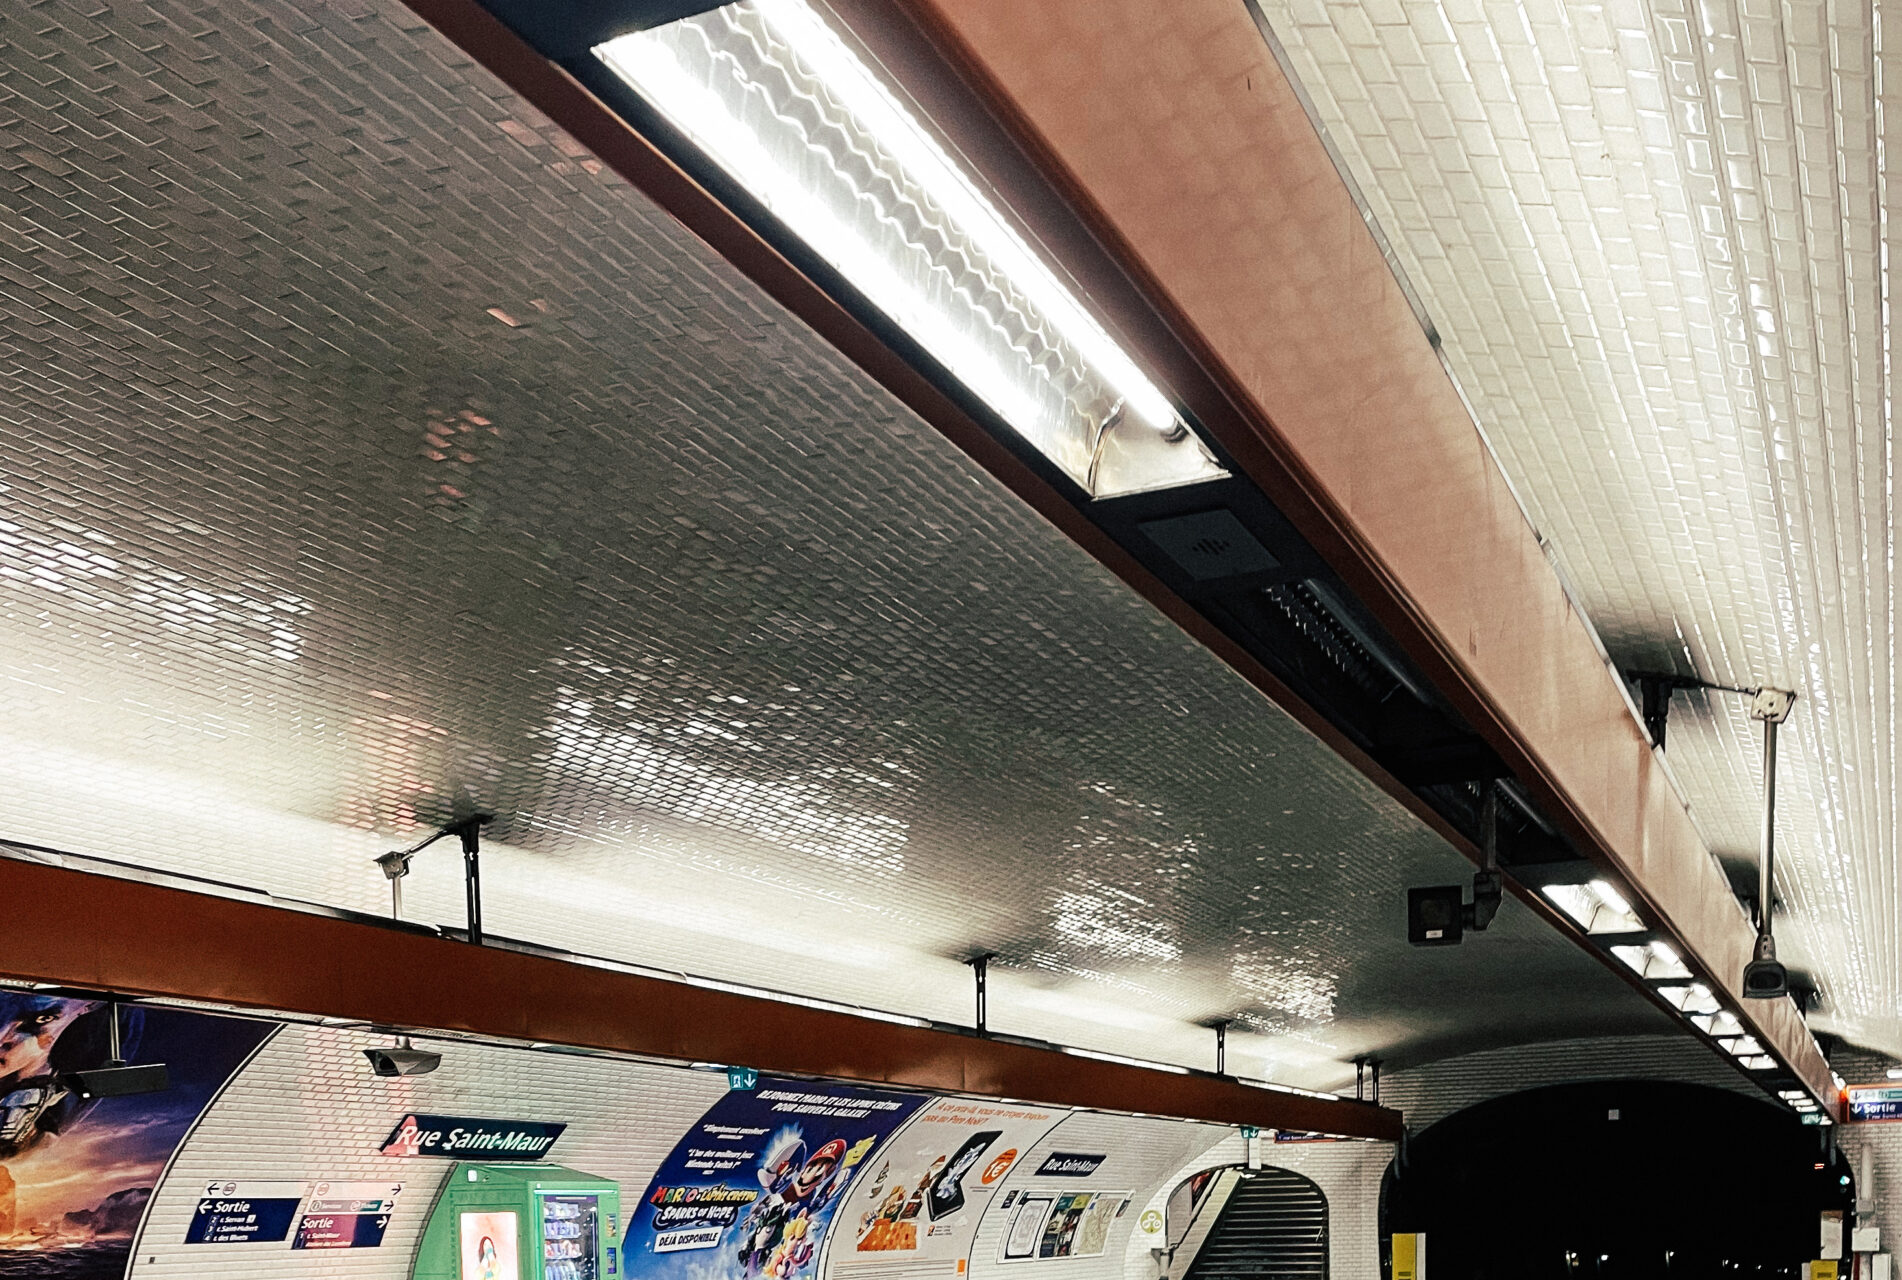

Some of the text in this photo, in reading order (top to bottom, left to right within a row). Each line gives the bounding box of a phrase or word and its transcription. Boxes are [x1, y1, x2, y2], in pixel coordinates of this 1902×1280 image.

[1864, 1102, 1896, 1114] Sortie
[394, 1125, 553, 1151] Rue Saint-Maur
[1042, 1158, 1100, 1172] Rue Saint-Maur
[650, 1186, 699, 1203] MARIO
[213, 1200, 251, 1214] Sortie
[661, 1206, 699, 1220] SPARKS
[706, 1206, 734, 1219] HOPE
[301, 1216, 334, 1229] Sortie
[659, 1232, 718, 1247] DÉJÀ DISPONIBLE
